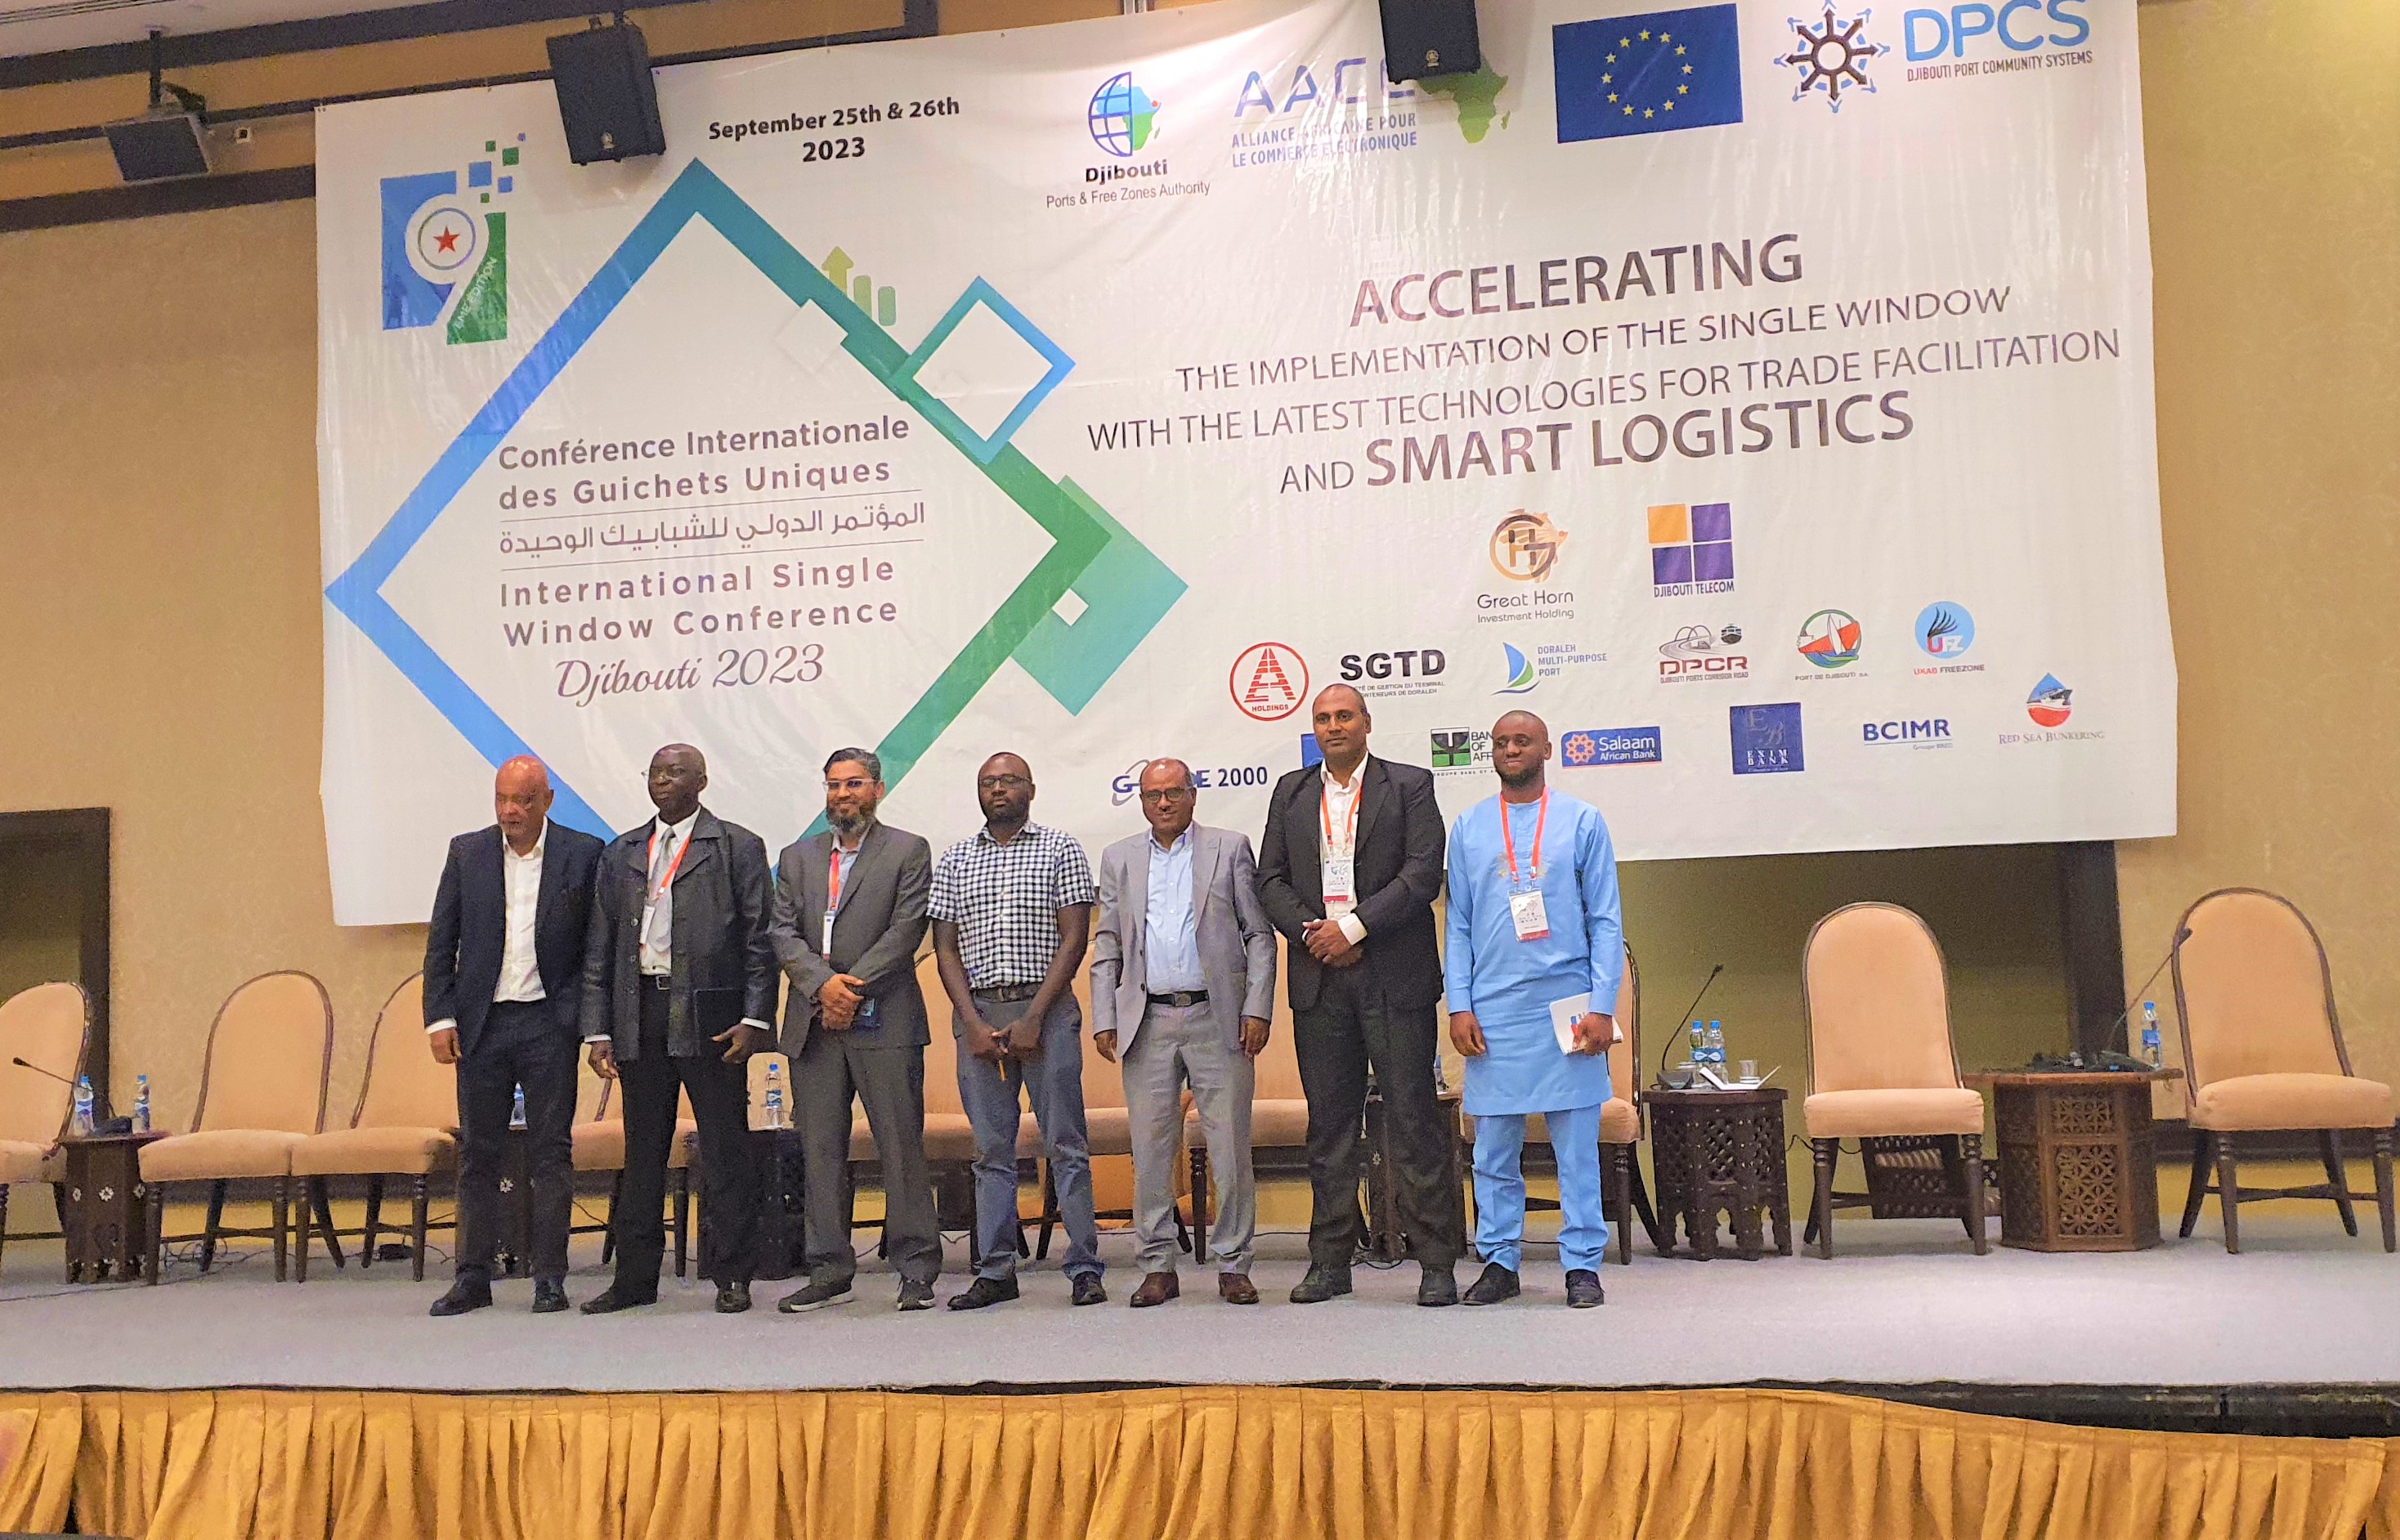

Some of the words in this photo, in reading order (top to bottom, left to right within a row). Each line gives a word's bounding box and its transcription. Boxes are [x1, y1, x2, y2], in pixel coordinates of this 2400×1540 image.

[1904, 0, 2090, 61] DPCS
[1907, 65, 1951, 82] DJIBOUTI
[1954, 62, 1979, 78] PORT
[1983, 55, 2043, 74] COMMUNITY
[2045, 50, 2093, 68] SYSTEMS
[709, 113, 827, 141] September
[832, 105, 881, 126] 25th
[887, 102, 903, 119] &
[909, 96, 960, 118] 26th
[1232, 127, 1295, 148] ALLIANCE
[1379, 113, 1416, 131] POUR
[802, 136, 865, 162] 2023
[1233, 153, 1247, 168] LE
[1086, 159, 1167, 185] Djibouti
[1046, 193, 1076, 208] Ports
[1079, 191, 1087, 204] &
[1091, 190, 1117, 204] Free
[1121, 186, 1157, 201] Zones
[1159, 181, 1211, 197] Authority
[1350, 234, 1803, 327] ACCELERATING
[1175, 362, 1239, 393] THE
[1249, 332, 1551, 387] IMPLEMENTATION
[1562, 325, 1609, 356] OF
[1617, 318, 1687, 350] THE
[1699, 304, 1827, 342] SINGLE
[1836, 285, 2011, 327] WINDOW
[1087, 418, 1171, 451] WITH
[1179, 410, 1243, 442] THE
[1253, 399, 1370, 437] LATEST
[1377, 373, 1647, 426] TECHNOLOGIES
[1659, 365, 1731, 401] FOR
[1738, 351, 1862, 393] TRADE
[1874, 328, 2120, 379] FACILITATION
[499, 438, 675, 471] Conférence
[687, 414, 910, 456] Internationale
[1280, 460, 1354, 495] AND
[1367, 419, 1573, 486] SMART
[1592, 390, 1914, 467] LOGISTICS
[499, 485, 557, 510] des
[574, 472, 728, 504] Guichets
[746, 462, 889, 491] Uniques
[601, 513, 728, 552] للشبابيك
[736, 508, 823, 549] الدولي
[831, 501, 925, 535] المؤتمر
[499, 526, 593, 558] الوحيدة
[501, 565, 751, 607] International
[773, 557, 893, 589] Single
[1654, 584, 1693, 598] DJIBOUTI
[1695, 580, 1735, 595] TELECOM
[1477, 593, 1529, 609] Great
[1534, 589, 1574, 606] Horn
[504, 616, 653, 647] Window
[674, 602, 898, 635] Conference
[1477, 612, 1533, 624] Investment
[1535, 609, 1574, 620] Holding
[1340, 649, 1446, 681] SGTD
[1538, 644, 1576, 654] DORALEH
[1538, 653, 1608, 665] MULTI-PURPOSE
[555, 656, 703, 708] Djibouti
[712, 643, 825, 687] 2023
[1538, 668, 1560, 676] PORT
[1659, 656, 1748, 675] DPCR
[1471, 741, 1486, 751] OF
[1599, 736, 1655, 751] Salaam
[1863, 719, 1951, 741] BCIMR
[1999, 734, 2021, 744] RED
[2023, 733, 2042, 743] SEA
[1600, 752, 1631, 761] African
[1633, 750, 1656, 759] Bank
[1218, 767, 1267, 787] 2000
